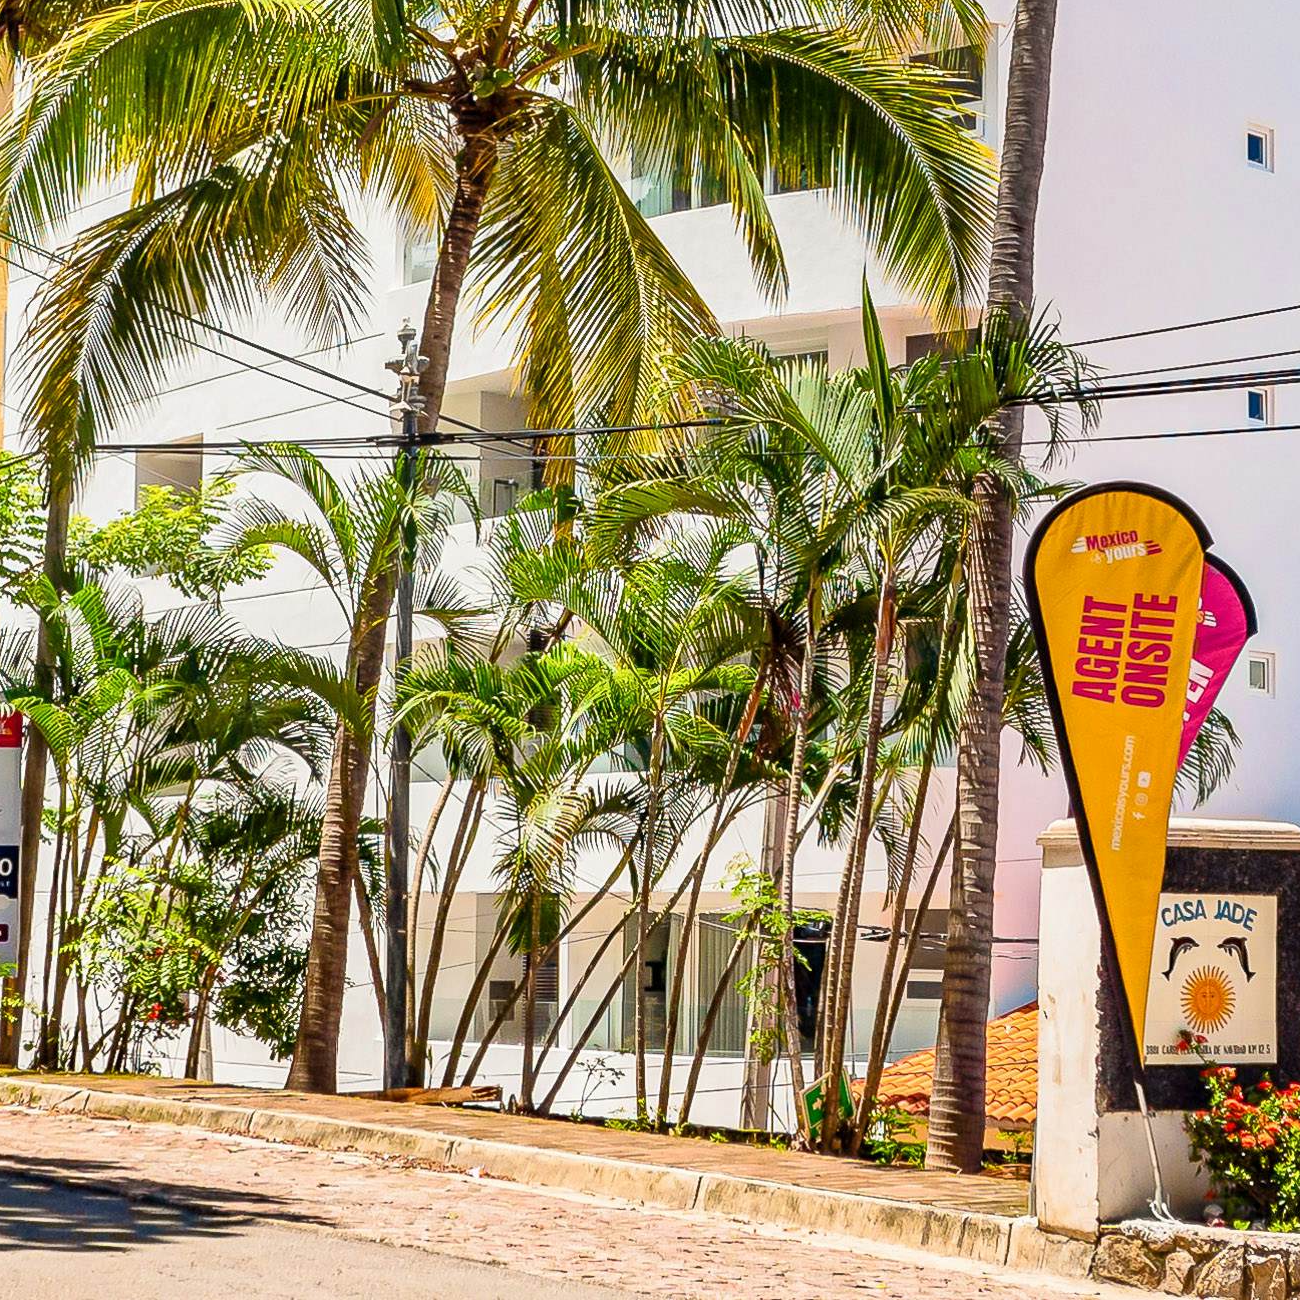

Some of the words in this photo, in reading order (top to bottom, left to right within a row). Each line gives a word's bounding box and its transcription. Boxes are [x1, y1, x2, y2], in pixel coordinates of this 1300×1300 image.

[1085, 530, 1138, 552] Mexico
[1104, 543, 1147, 564] yours
[1072, 595, 1127, 704] AGENT
[1120, 593, 1178, 708] ONSITE
[1111, 735, 1136, 851] mexicoisyours.com
[1161, 899, 1207, 927] CASA
[1214, 899, 1258, 932] JADE
